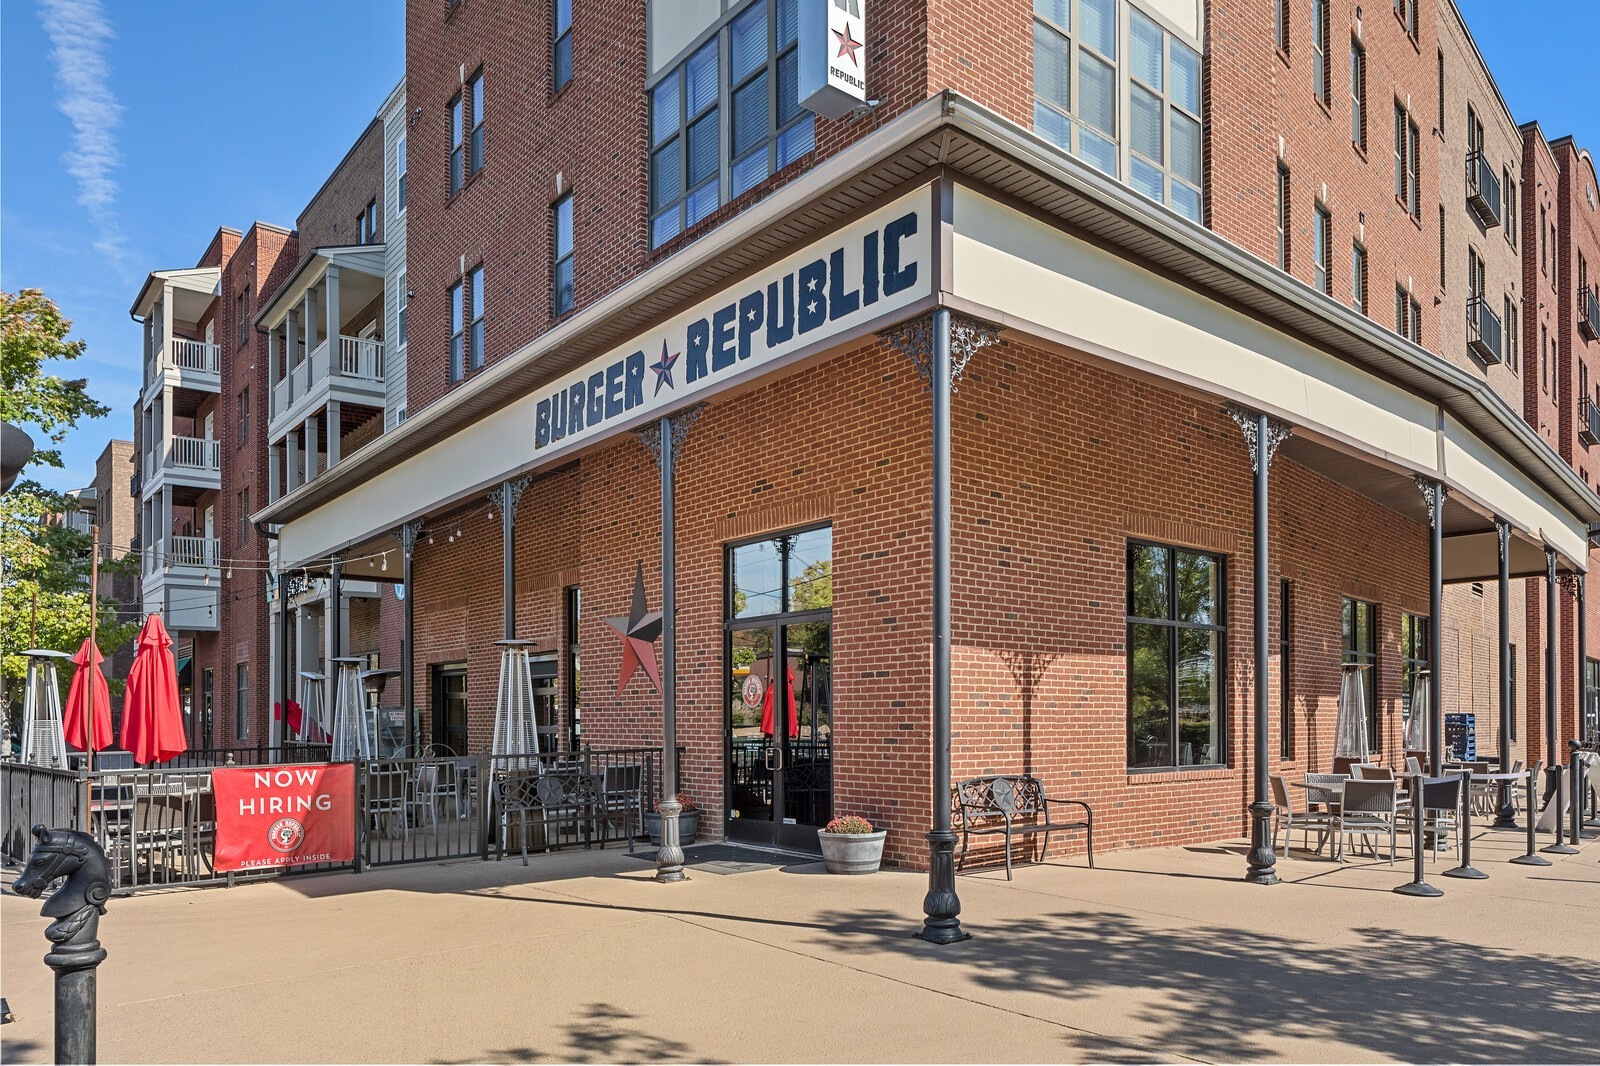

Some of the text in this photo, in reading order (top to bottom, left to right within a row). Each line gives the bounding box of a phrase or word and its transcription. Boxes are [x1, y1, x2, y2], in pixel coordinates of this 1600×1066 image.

[830, 65, 865, 91] REPUBLIC
[535, 211, 917, 449] BURGER REPUBLIC
[254, 769, 318, 789] NOW
[239, 793, 332, 816] HIRING
[240, 853, 331, 868] PLEASE APPLY INSIDE
